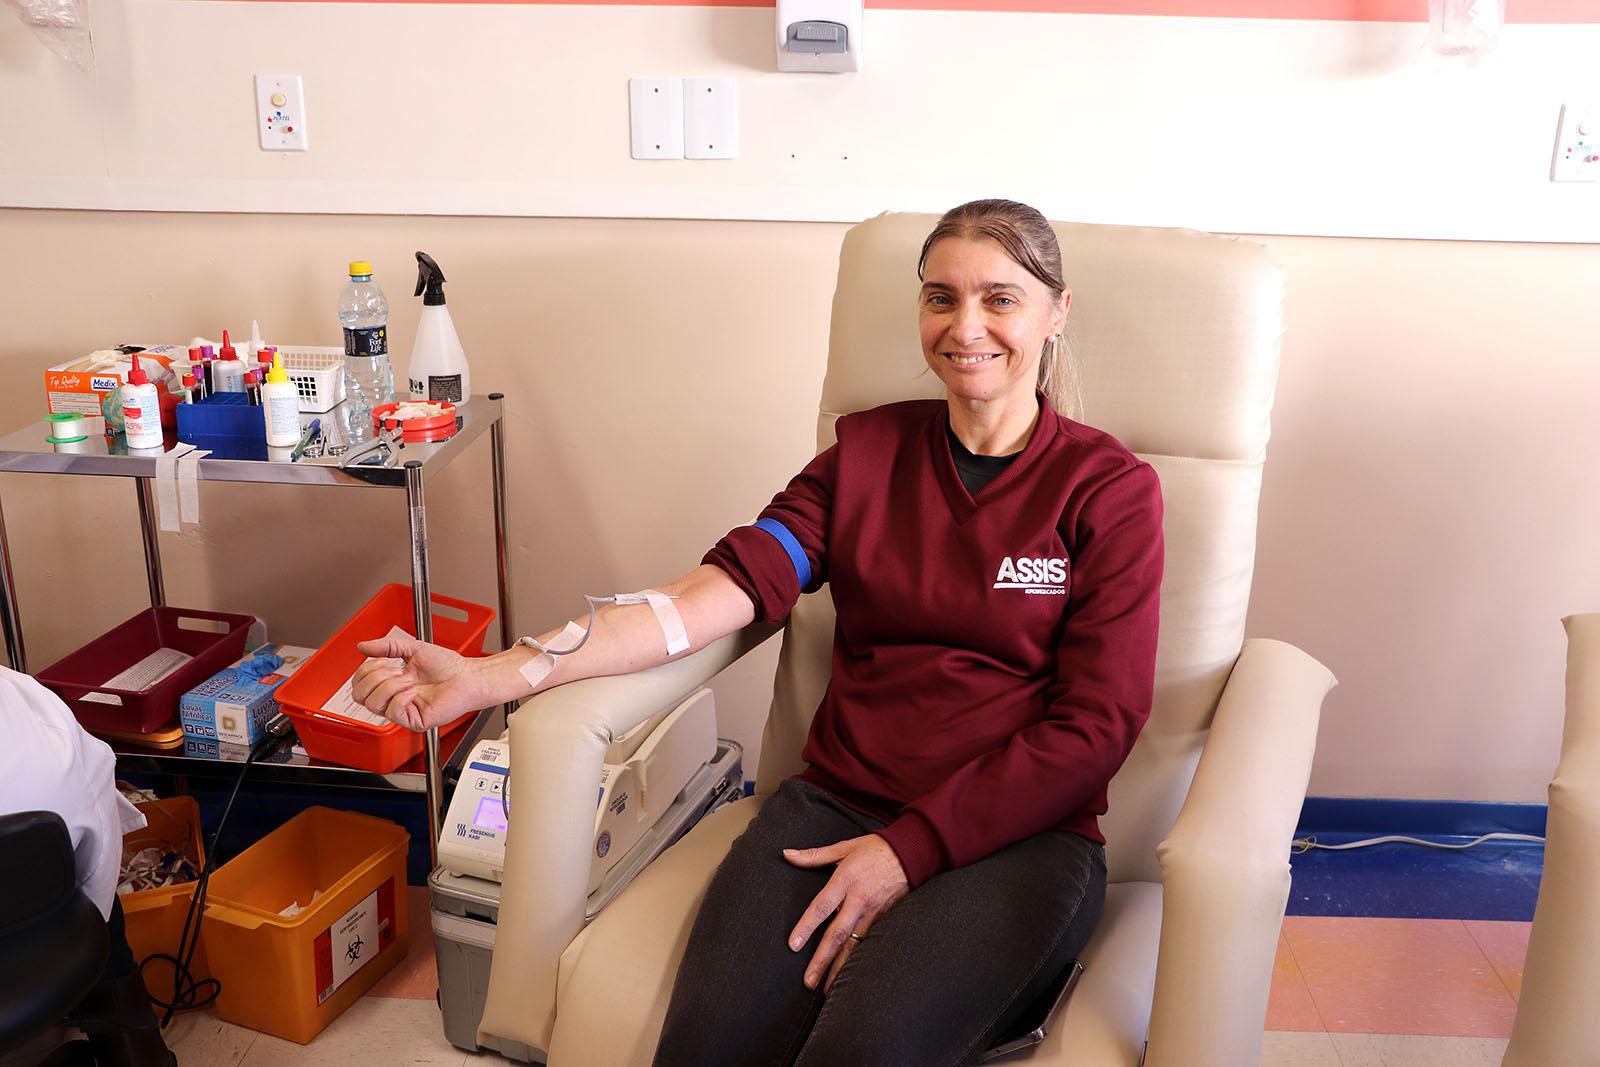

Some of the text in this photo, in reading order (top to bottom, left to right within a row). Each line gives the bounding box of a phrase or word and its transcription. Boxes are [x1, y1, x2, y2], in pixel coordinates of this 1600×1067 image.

[93, 379, 116, 388] Medix
[996, 556, 1067, 583] ASSIS
[182, 703, 202, 713] Luvas
[470, 828, 496, 839] FRESENIUS
